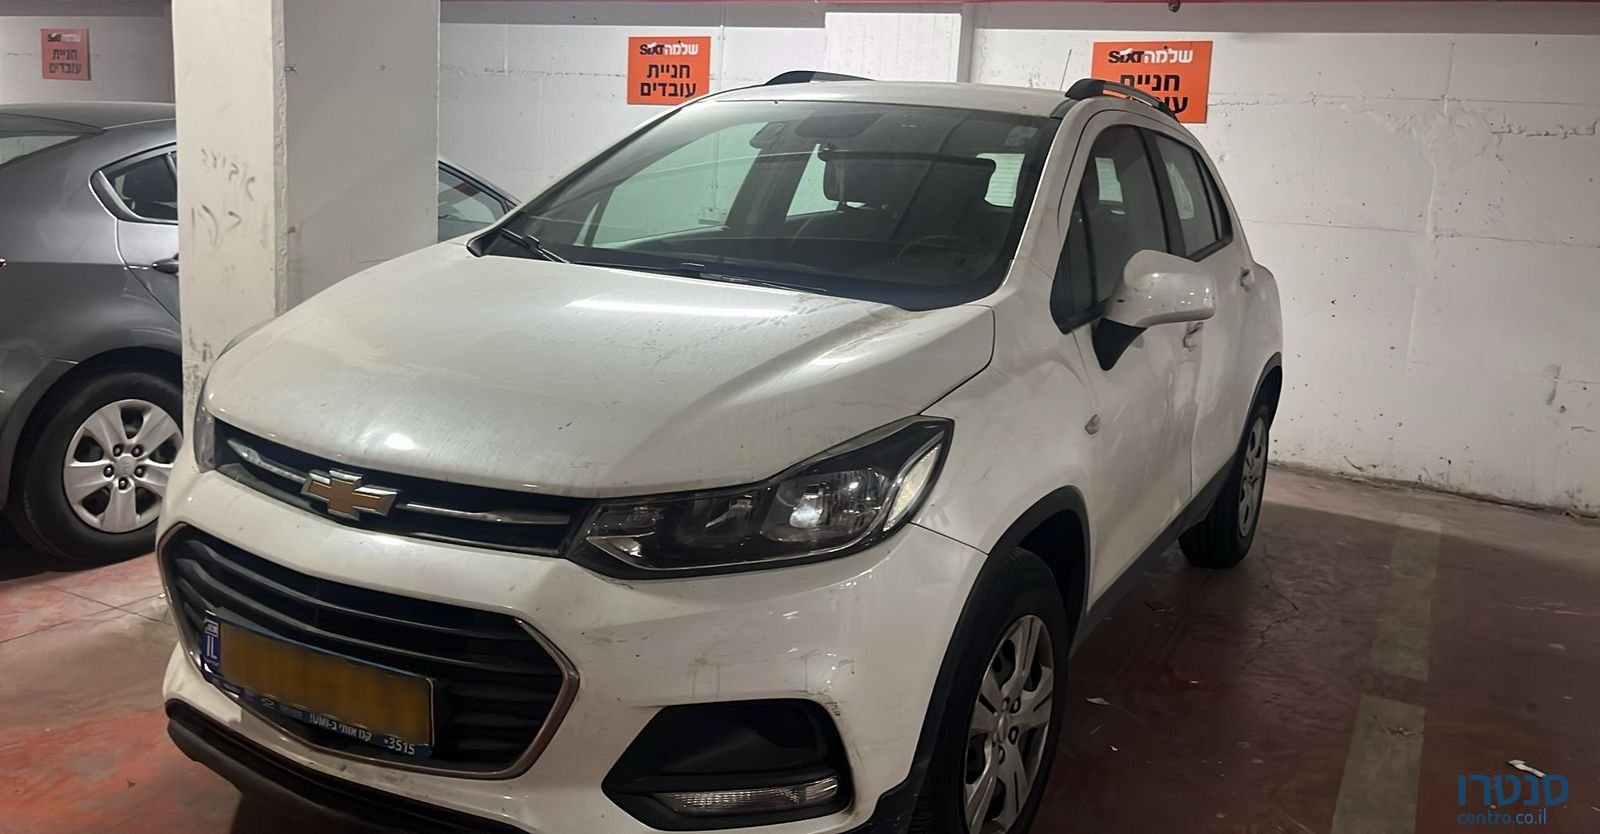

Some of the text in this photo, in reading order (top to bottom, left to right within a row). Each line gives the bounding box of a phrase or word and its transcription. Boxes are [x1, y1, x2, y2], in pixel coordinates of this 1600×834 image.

[646, 64, 690, 78] חניית
[640, 82, 697, 98] עובדים
[206, 635, 218, 660] IL
